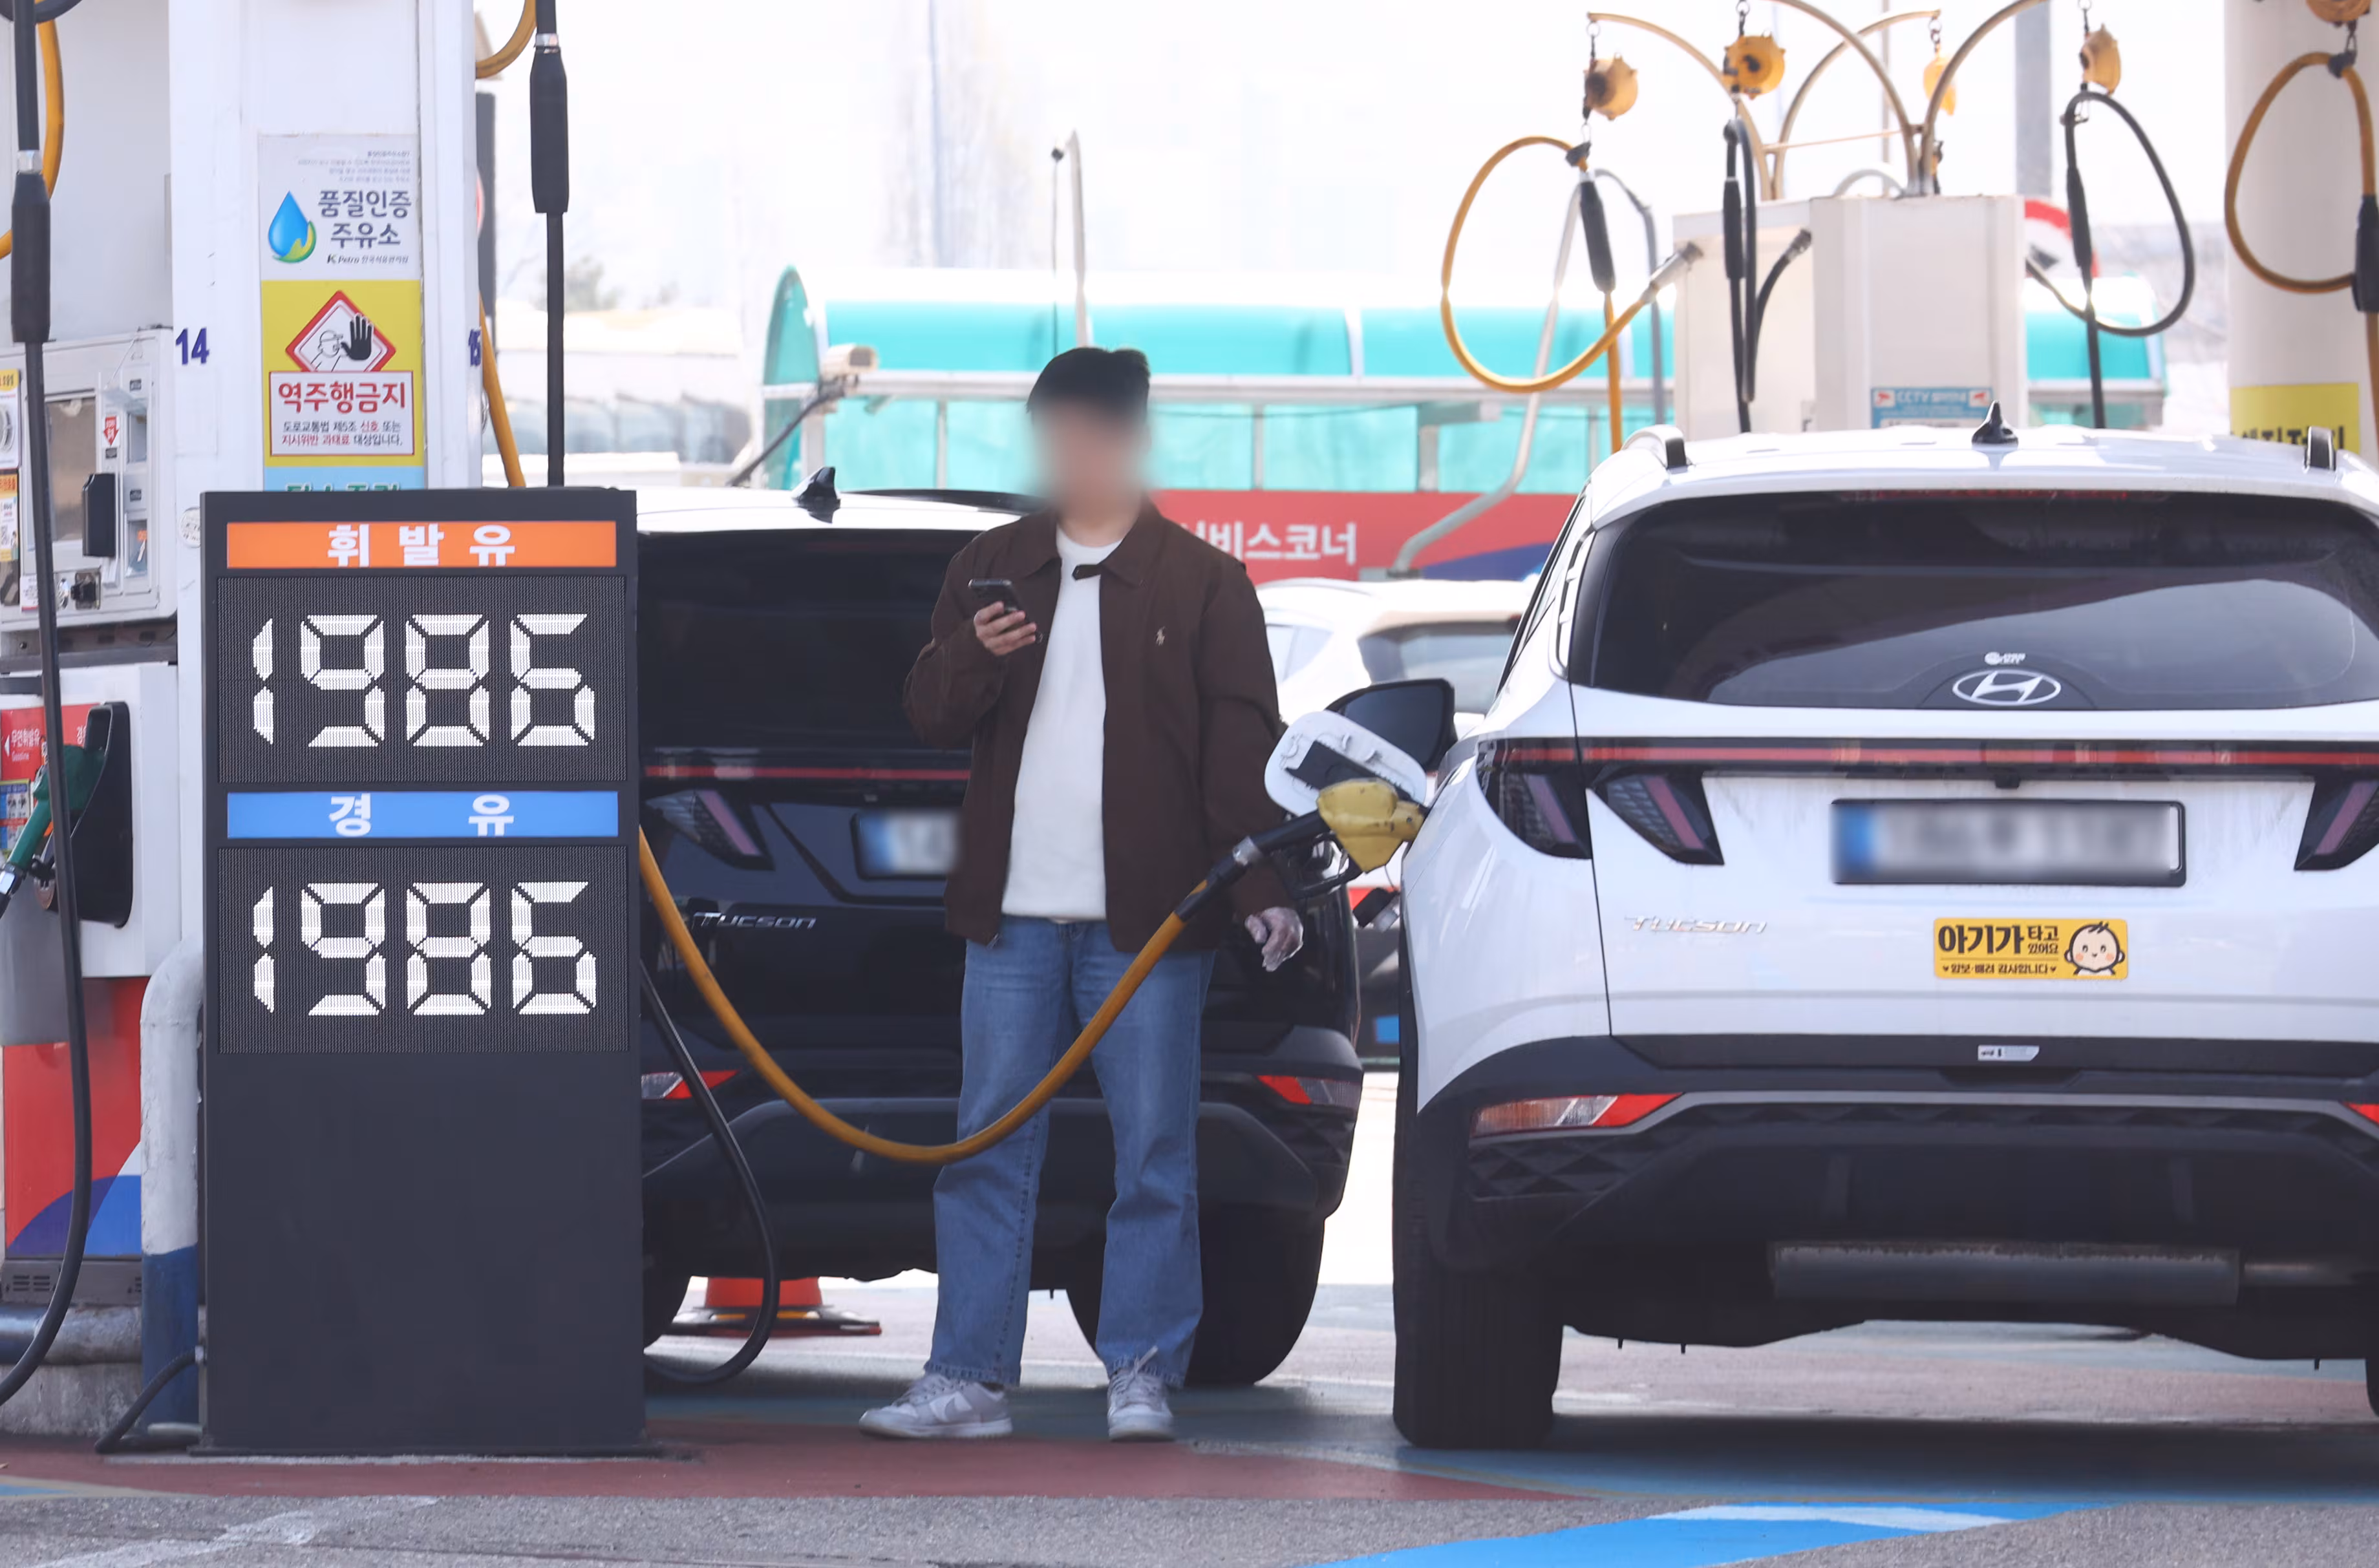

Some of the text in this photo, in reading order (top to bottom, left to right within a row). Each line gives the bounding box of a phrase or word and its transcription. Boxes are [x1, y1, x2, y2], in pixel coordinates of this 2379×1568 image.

[318, 189, 412, 218] 품질인증
[330, 222, 401, 249] 주유소
[176, 327, 209, 365] 14
[278, 381, 405, 414] 역주행금지
[282, 434, 402, 446] 지시위반 과태료 대상입니다.
[284, 421, 401, 432] 도로교통법 제5조 신호 또는
[327, 524, 515, 567] 휘발유
[253, 613, 595, 747] 1986
[253, 882, 596, 1015] 1986
[1938, 925, 2059, 954] 아기가 타고
[2028, 942, 2059, 955] 있어요
[1998, 964, 2048, 975] 감사합니다
